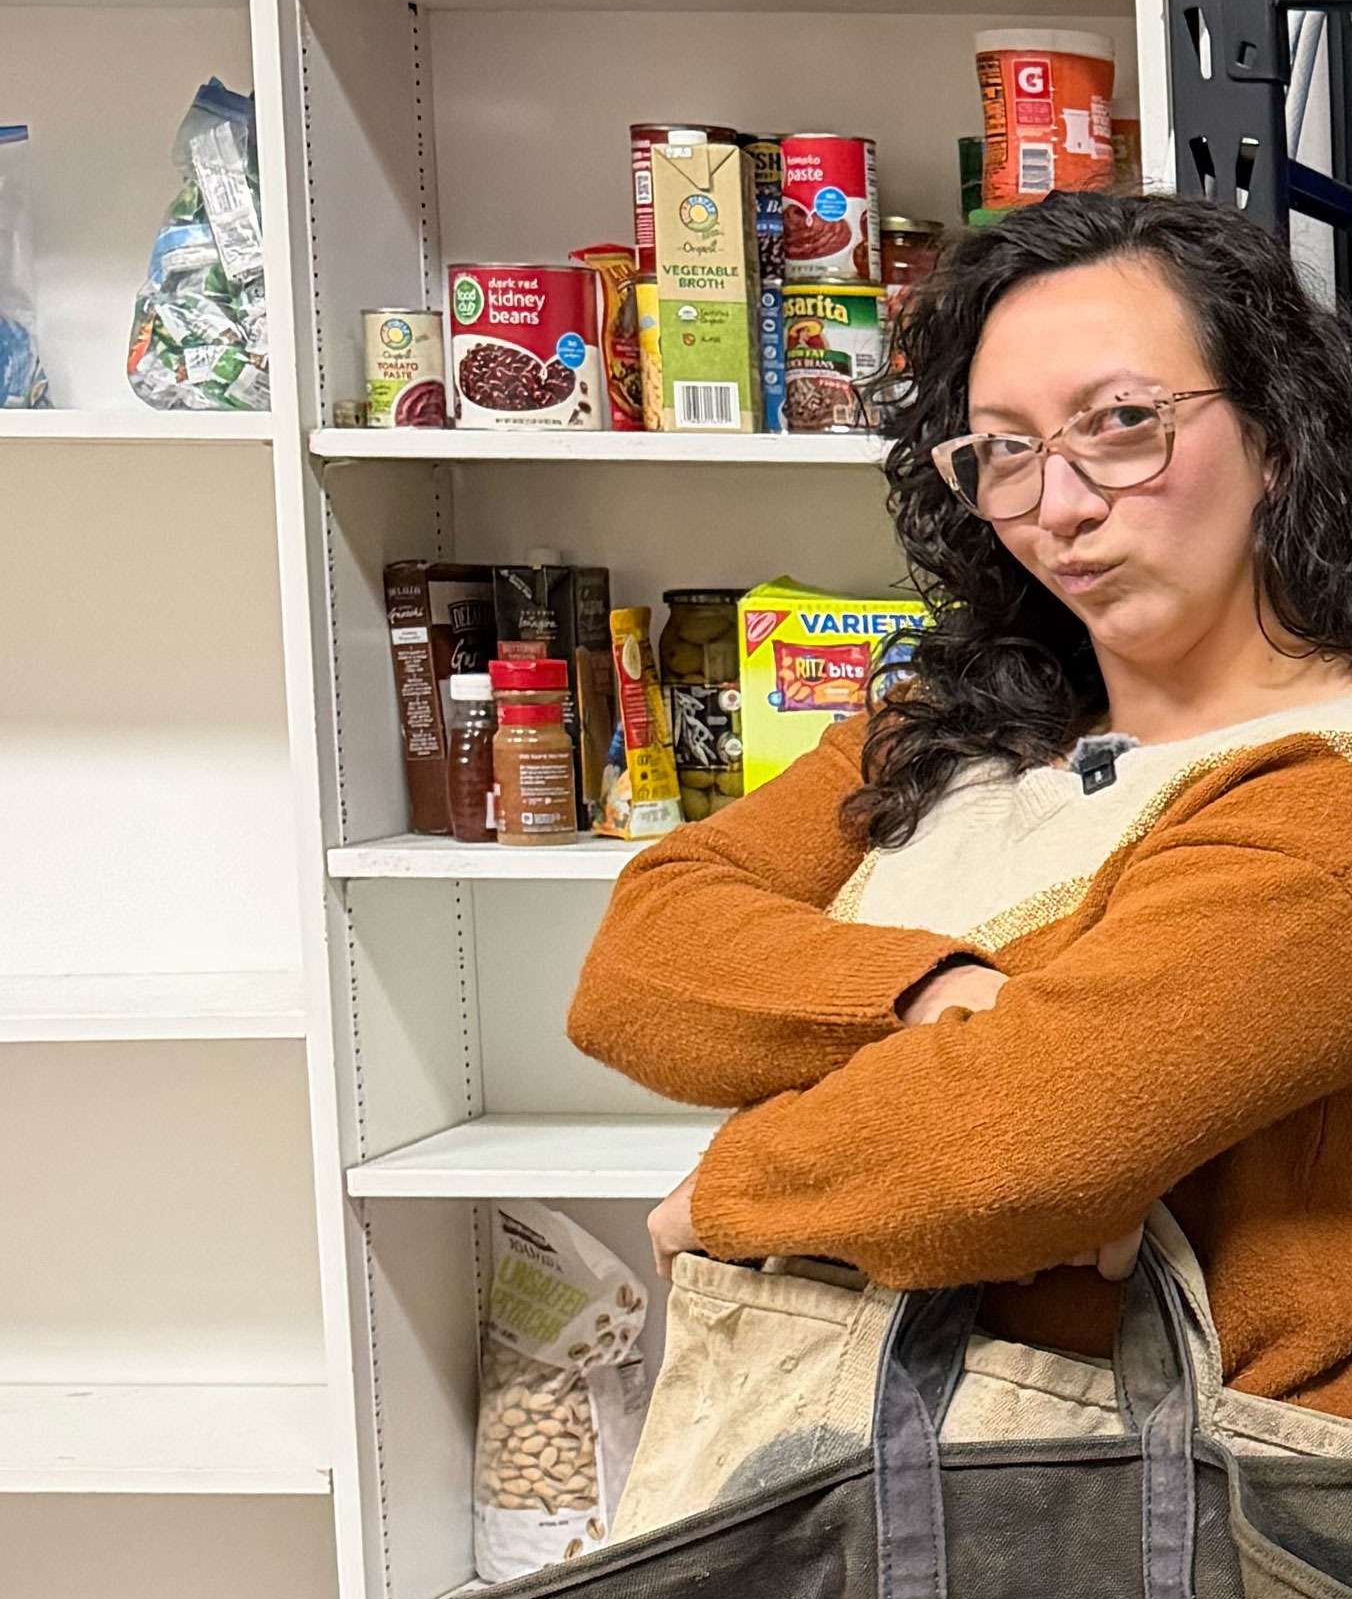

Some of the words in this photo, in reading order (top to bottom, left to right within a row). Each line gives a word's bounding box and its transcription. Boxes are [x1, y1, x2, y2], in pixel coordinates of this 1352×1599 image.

[1018, 66, 1044, 94] G
[787, 168, 823, 186] paste
[661, 265, 739, 277] VEGETABLE
[488, 277, 515, 290] dark
[518, 278, 538, 290] red
[678, 277, 725, 289] BROTH
[488, 289, 546, 312] kidney
[489, 310, 540, 325] beans
[383, 371, 413, 380] PASTE
[800, 613, 925, 634] VARIETY
[795, 657, 825, 679] RITZ
[828, 661, 865, 679] bits
